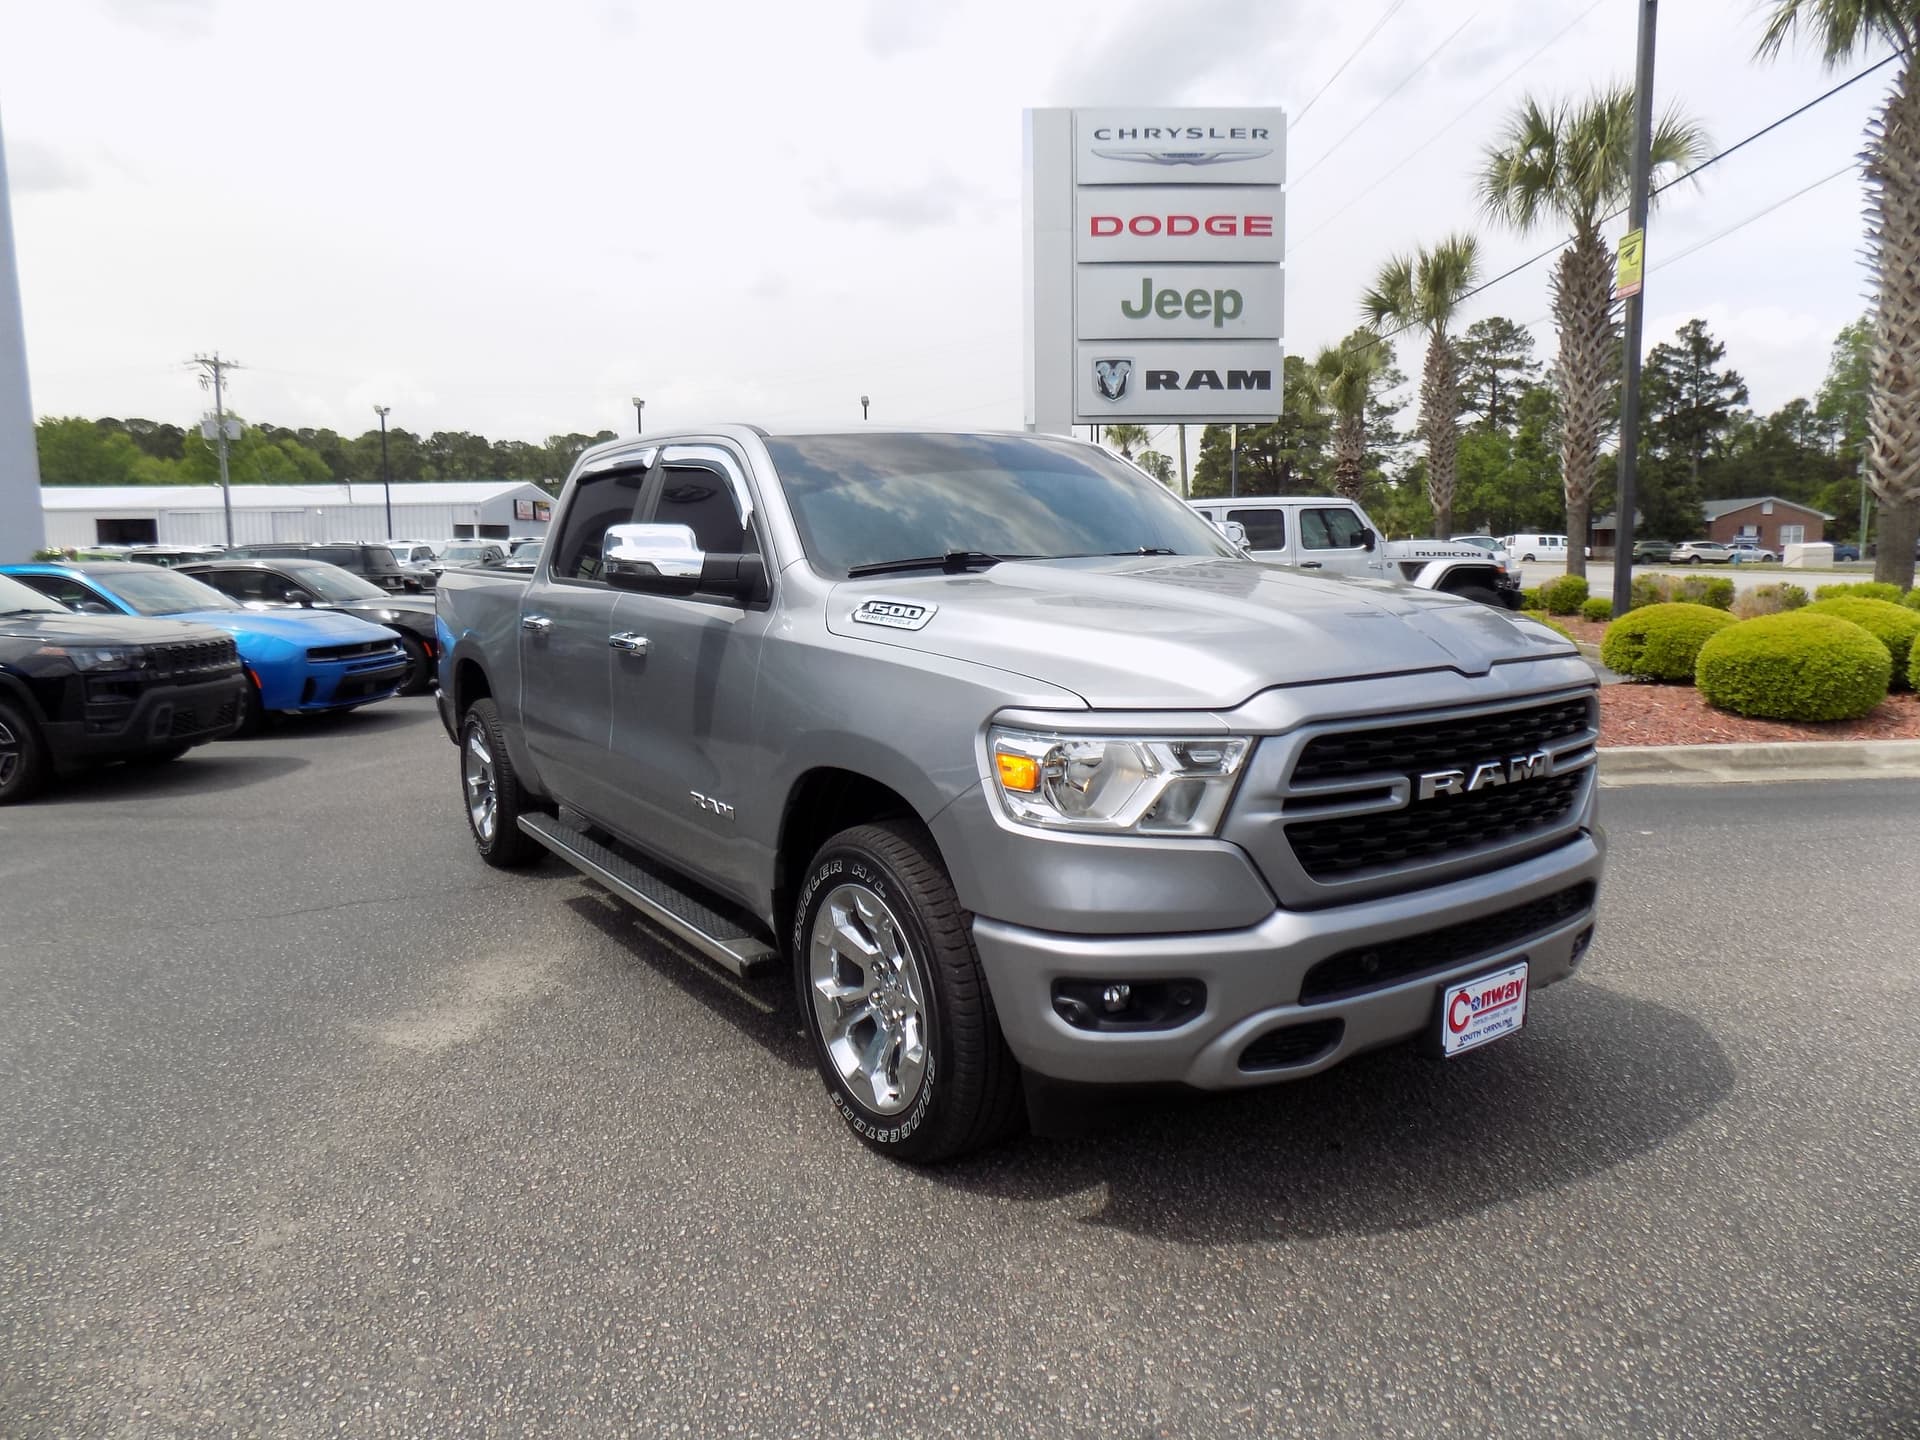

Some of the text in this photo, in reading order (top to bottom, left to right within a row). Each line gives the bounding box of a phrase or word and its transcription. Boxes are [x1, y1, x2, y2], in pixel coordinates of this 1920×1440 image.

[1094, 127, 1270, 140] CHRYSLER
[1090, 215, 1273, 237] DODGE
[1121, 278, 1243, 328] Jeep
[1145, 370, 1271, 391] RAM
[867, 602, 923, 619] 1500
[1419, 752, 1545, 800] RAM
[690, 791, 735, 821] RAM
[1448, 977, 1525, 1034] Conway
[1459, 1029, 1482, 1044] SOUTH
[831, 1050, 936, 1143] BRIDGESTONE
